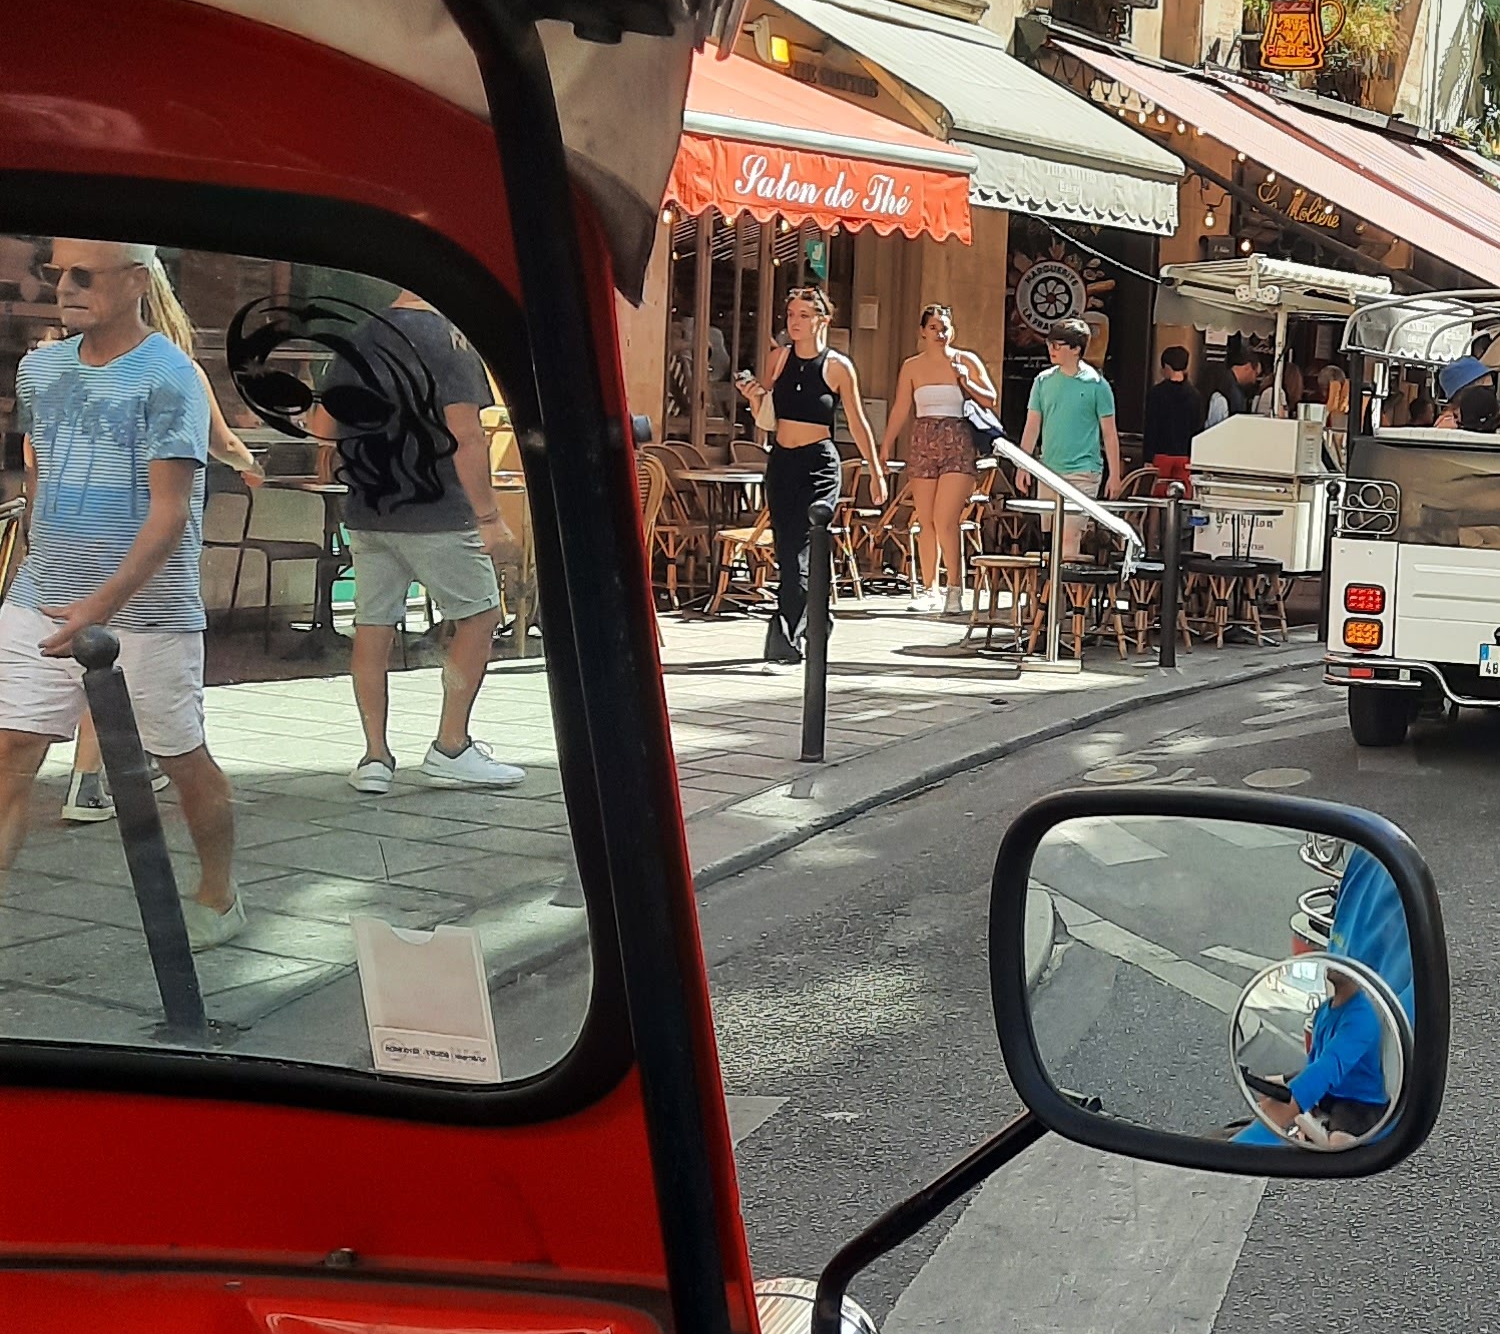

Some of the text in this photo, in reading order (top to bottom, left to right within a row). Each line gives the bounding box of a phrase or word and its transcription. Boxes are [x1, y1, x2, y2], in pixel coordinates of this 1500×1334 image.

[735, 154, 914, 217] Salon de Thé
